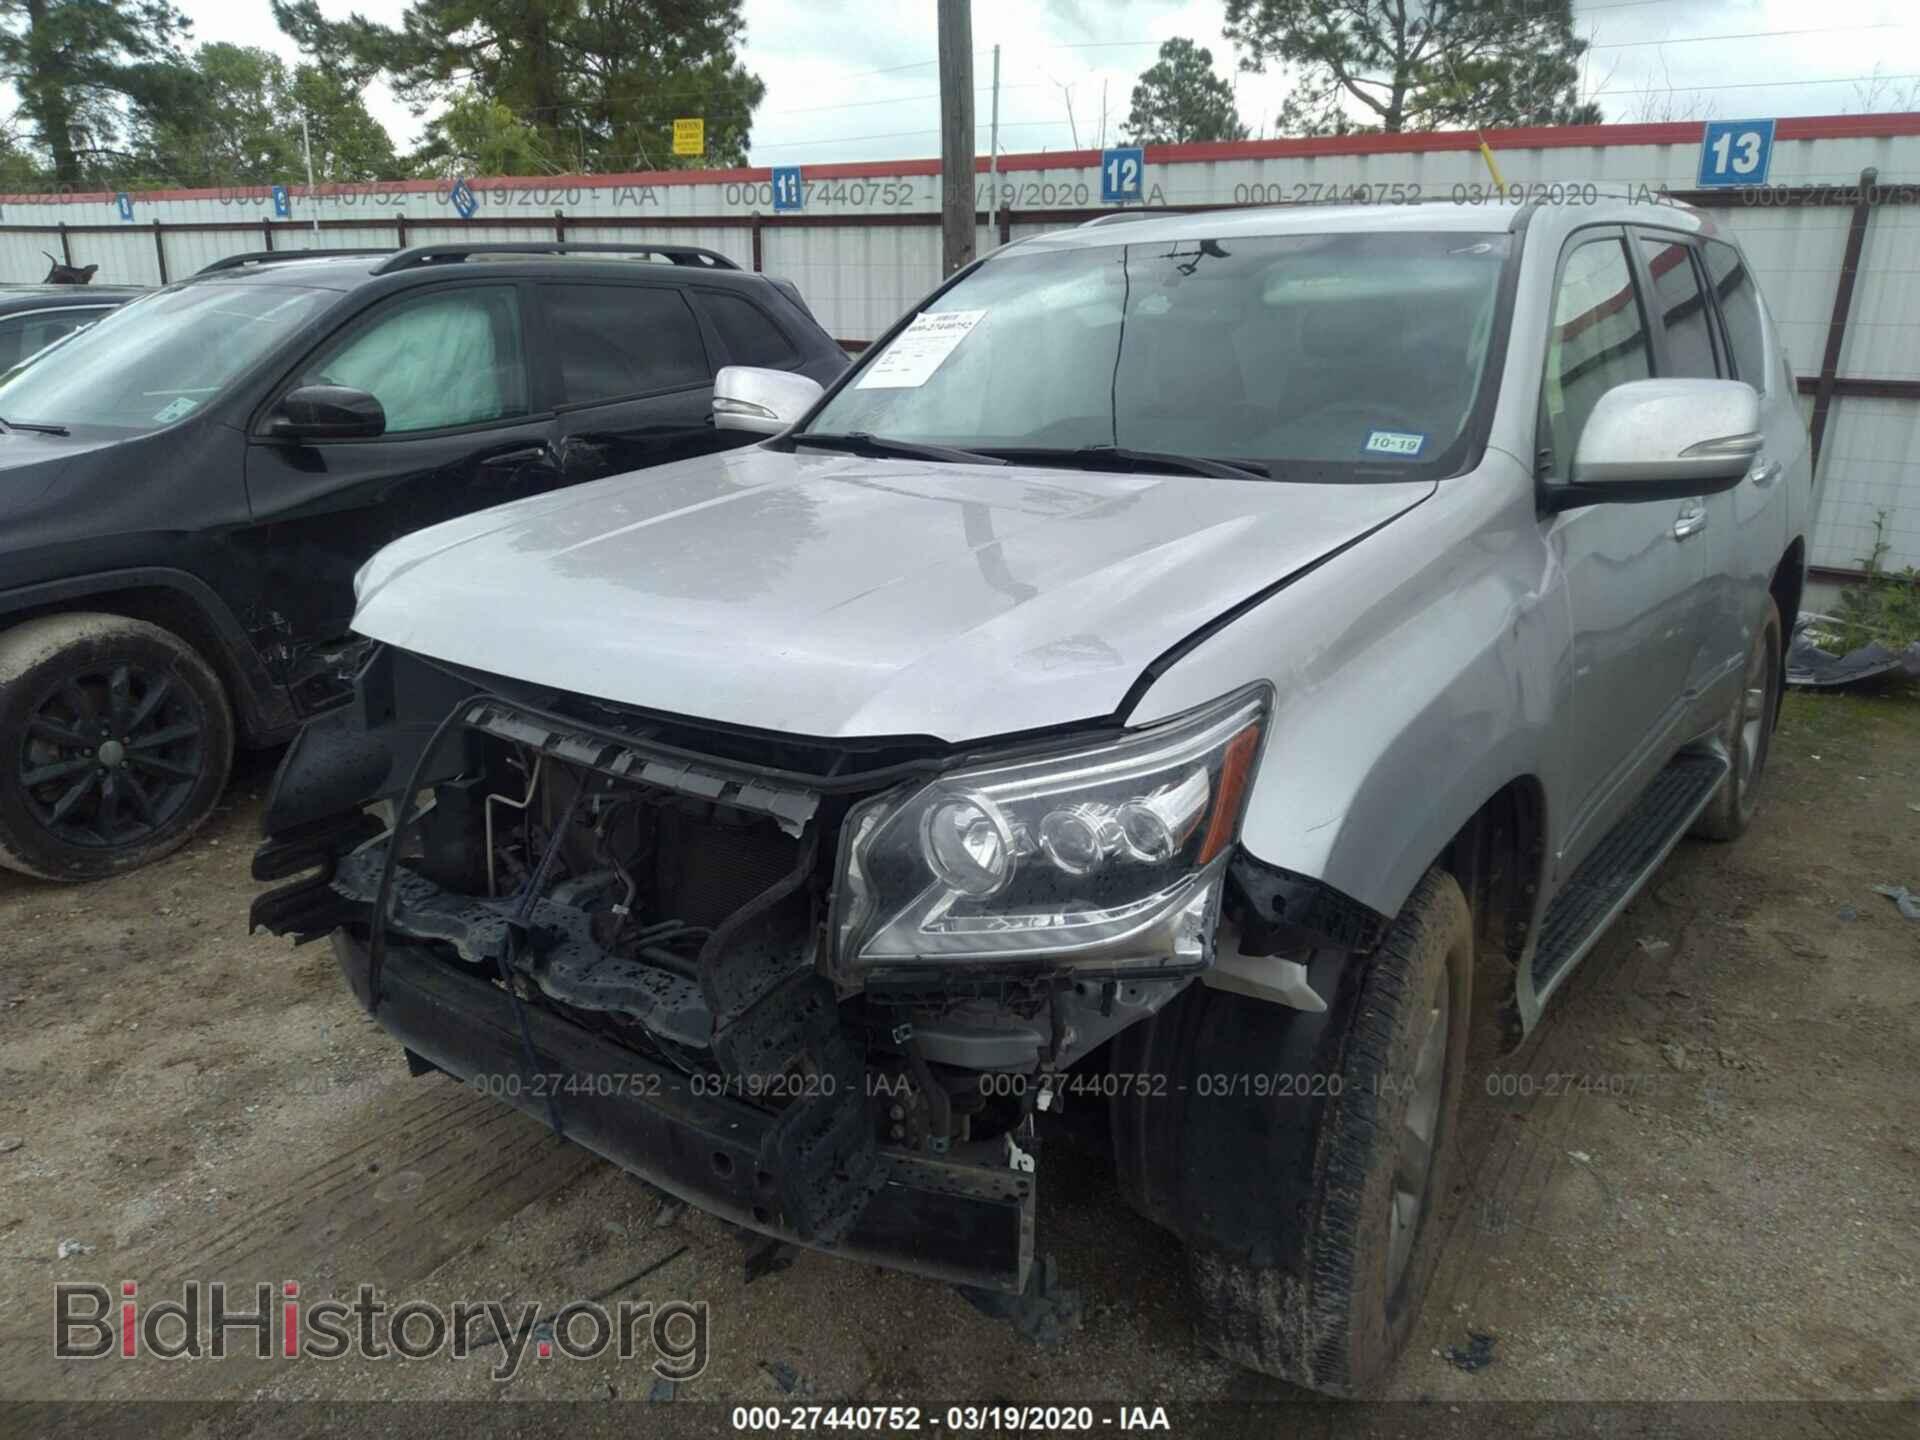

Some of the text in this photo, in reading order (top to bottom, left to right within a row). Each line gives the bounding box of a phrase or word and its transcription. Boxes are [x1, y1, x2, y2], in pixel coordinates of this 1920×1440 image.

[1712, 132, 1761, 173] 13
[778, 174, 797, 202] 11
[1107, 158, 1137, 192] 12
[1371, 437, 1418, 451] 10-19
